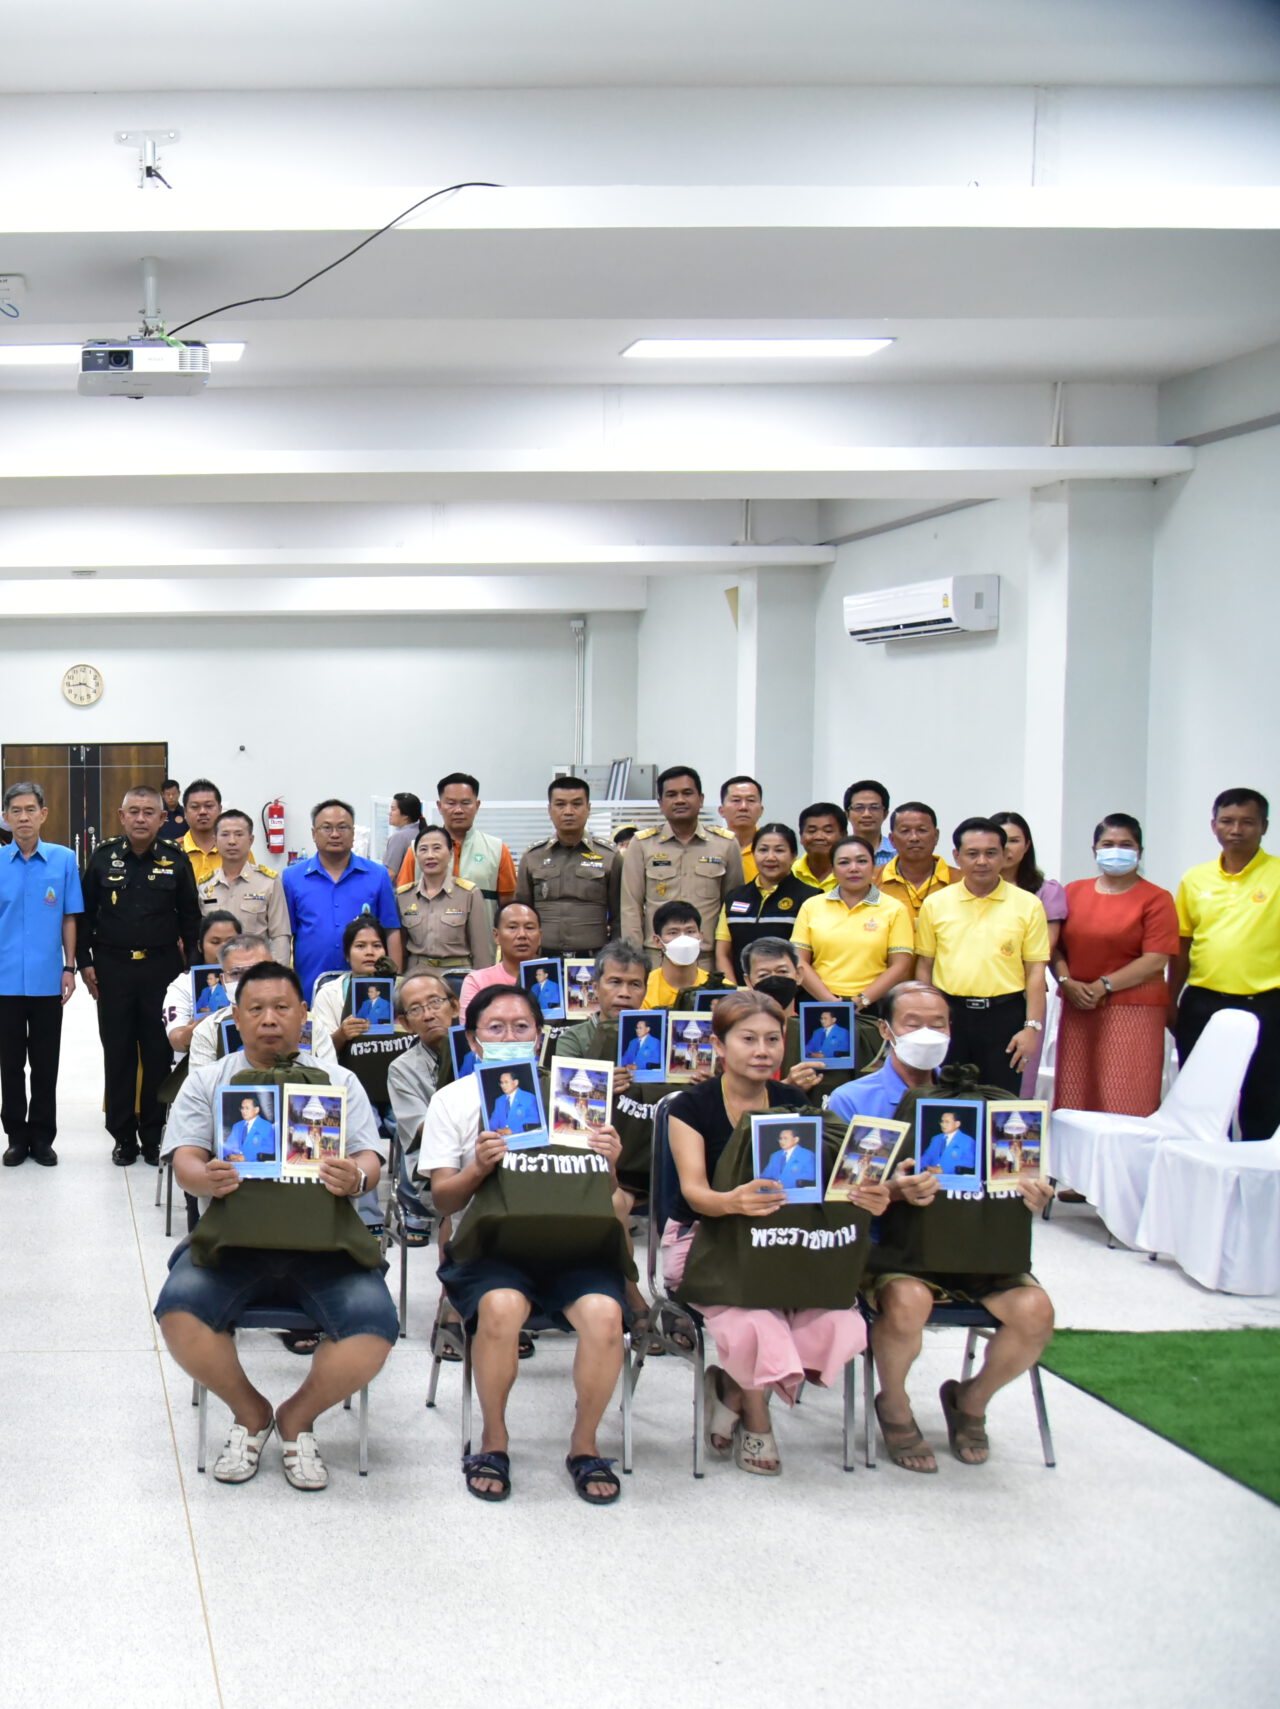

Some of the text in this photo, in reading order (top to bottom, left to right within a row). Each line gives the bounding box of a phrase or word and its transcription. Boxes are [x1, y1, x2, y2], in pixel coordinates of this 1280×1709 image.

[502, 1151, 610, 1174] พระราชทาน
[750, 1223, 857, 1250] พระราชทาน
